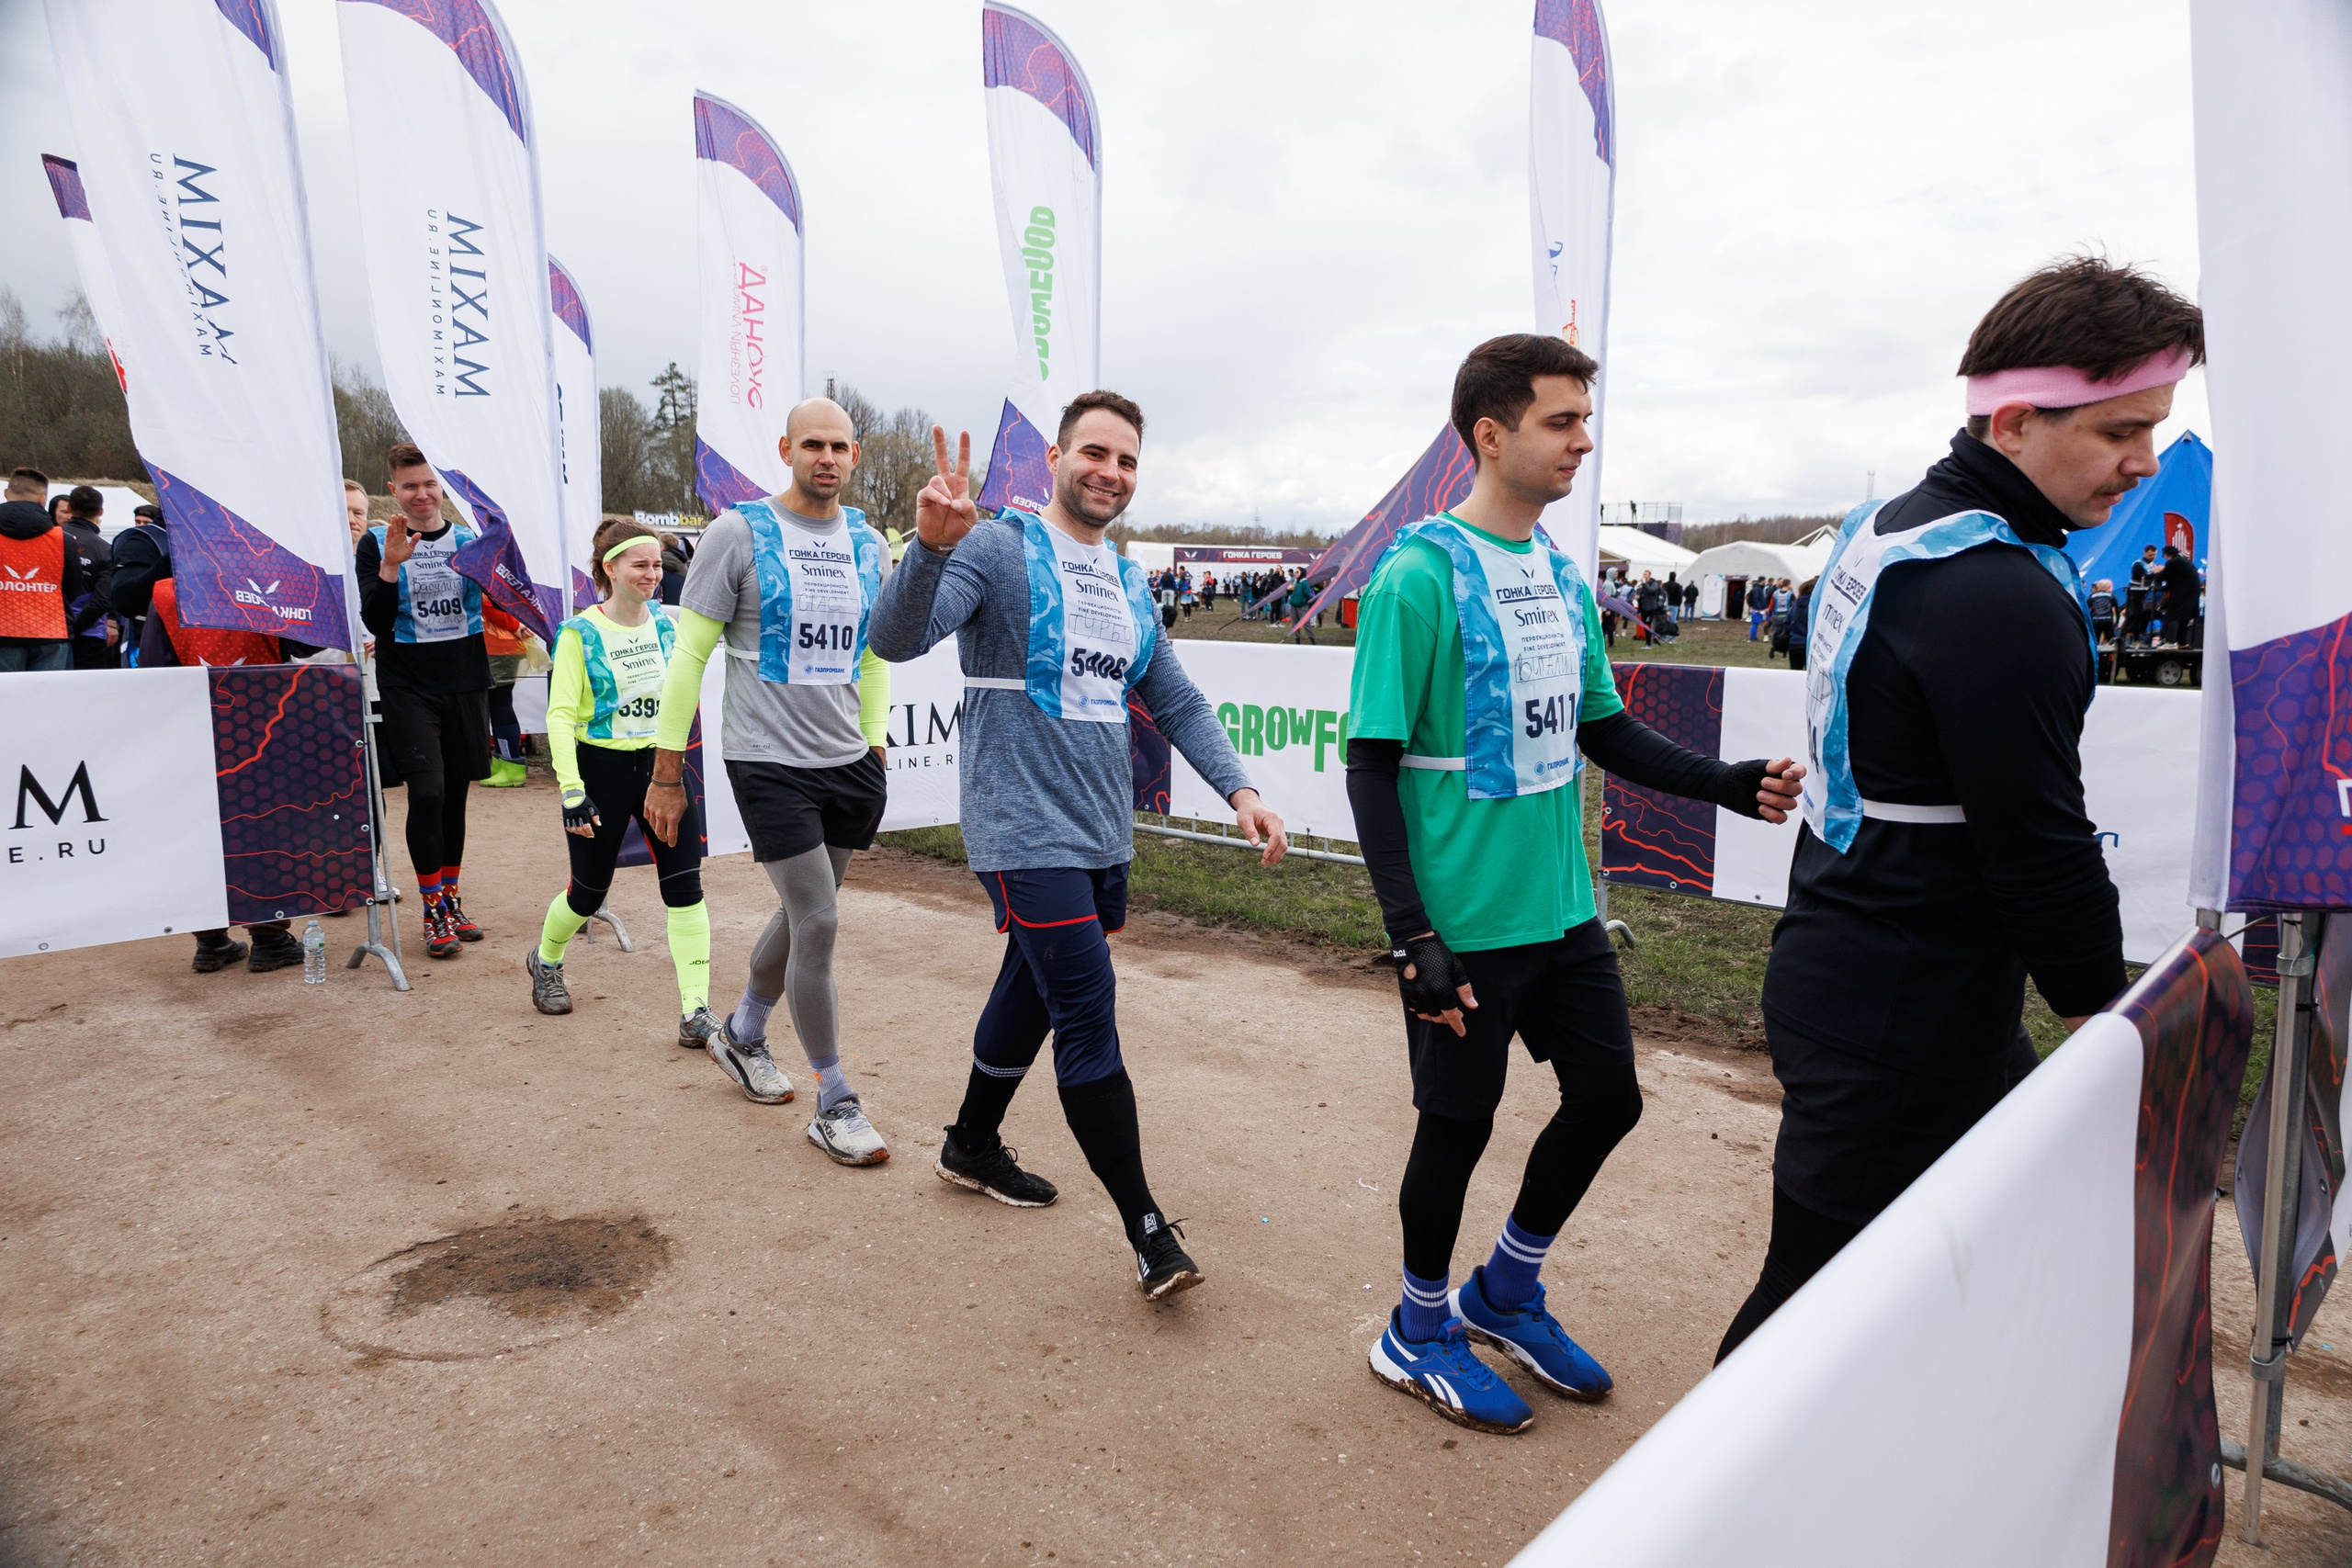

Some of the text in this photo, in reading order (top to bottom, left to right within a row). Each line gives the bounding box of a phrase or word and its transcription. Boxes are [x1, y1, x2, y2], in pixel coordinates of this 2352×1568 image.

[634, 511, 704, 526] Bombbar
[789, 549, 852, 561] ГОНКА ГЕРОЕВ
[1251, 551, 1283, 559] ГЕРОЕВ
[415, 561, 447, 570] Smine
[801, 564, 846, 579] Sminex
[1062, 561, 1095, 573] ГОНКА
[1075, 579, 1119, 603] Sminex
[1496, 583, 1557, 600] ГОНКА ГЕРОЕВ
[417, 598, 462, 618] 5409
[1514, 606, 1559, 627] Sminex
[798, 623, 854, 651] 5410
[610, 642, 659, 658] ГОНКА ГЕРОЕВ
[622, 657, 657, 671] Sminex
[618, 697, 660, 718] 539
[1525, 693, 1576, 739] 5411
